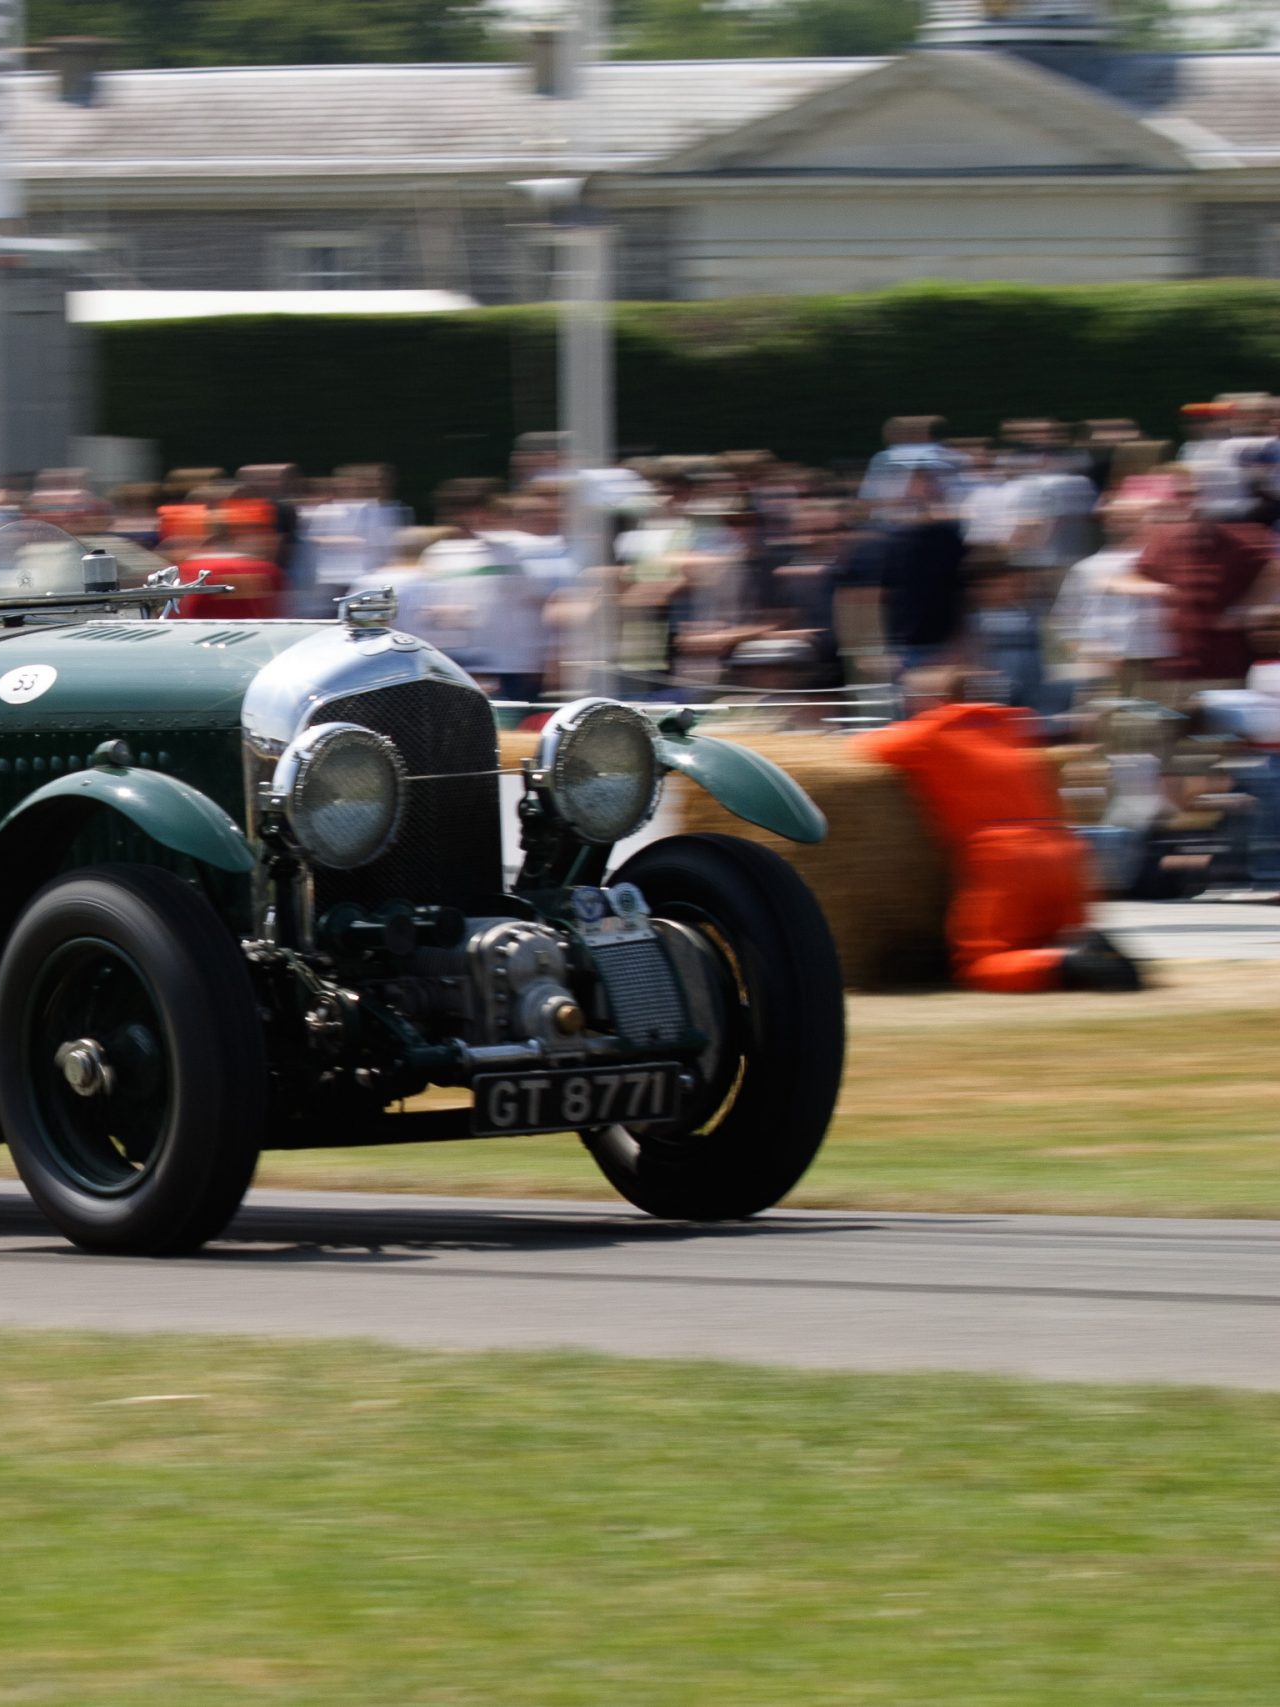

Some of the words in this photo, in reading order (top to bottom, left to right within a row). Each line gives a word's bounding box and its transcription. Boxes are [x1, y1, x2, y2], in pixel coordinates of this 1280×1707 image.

[13, 673, 38, 691] 53
[489, 1079, 550, 1127] GT
[561, 1071, 665, 1122] 8771
